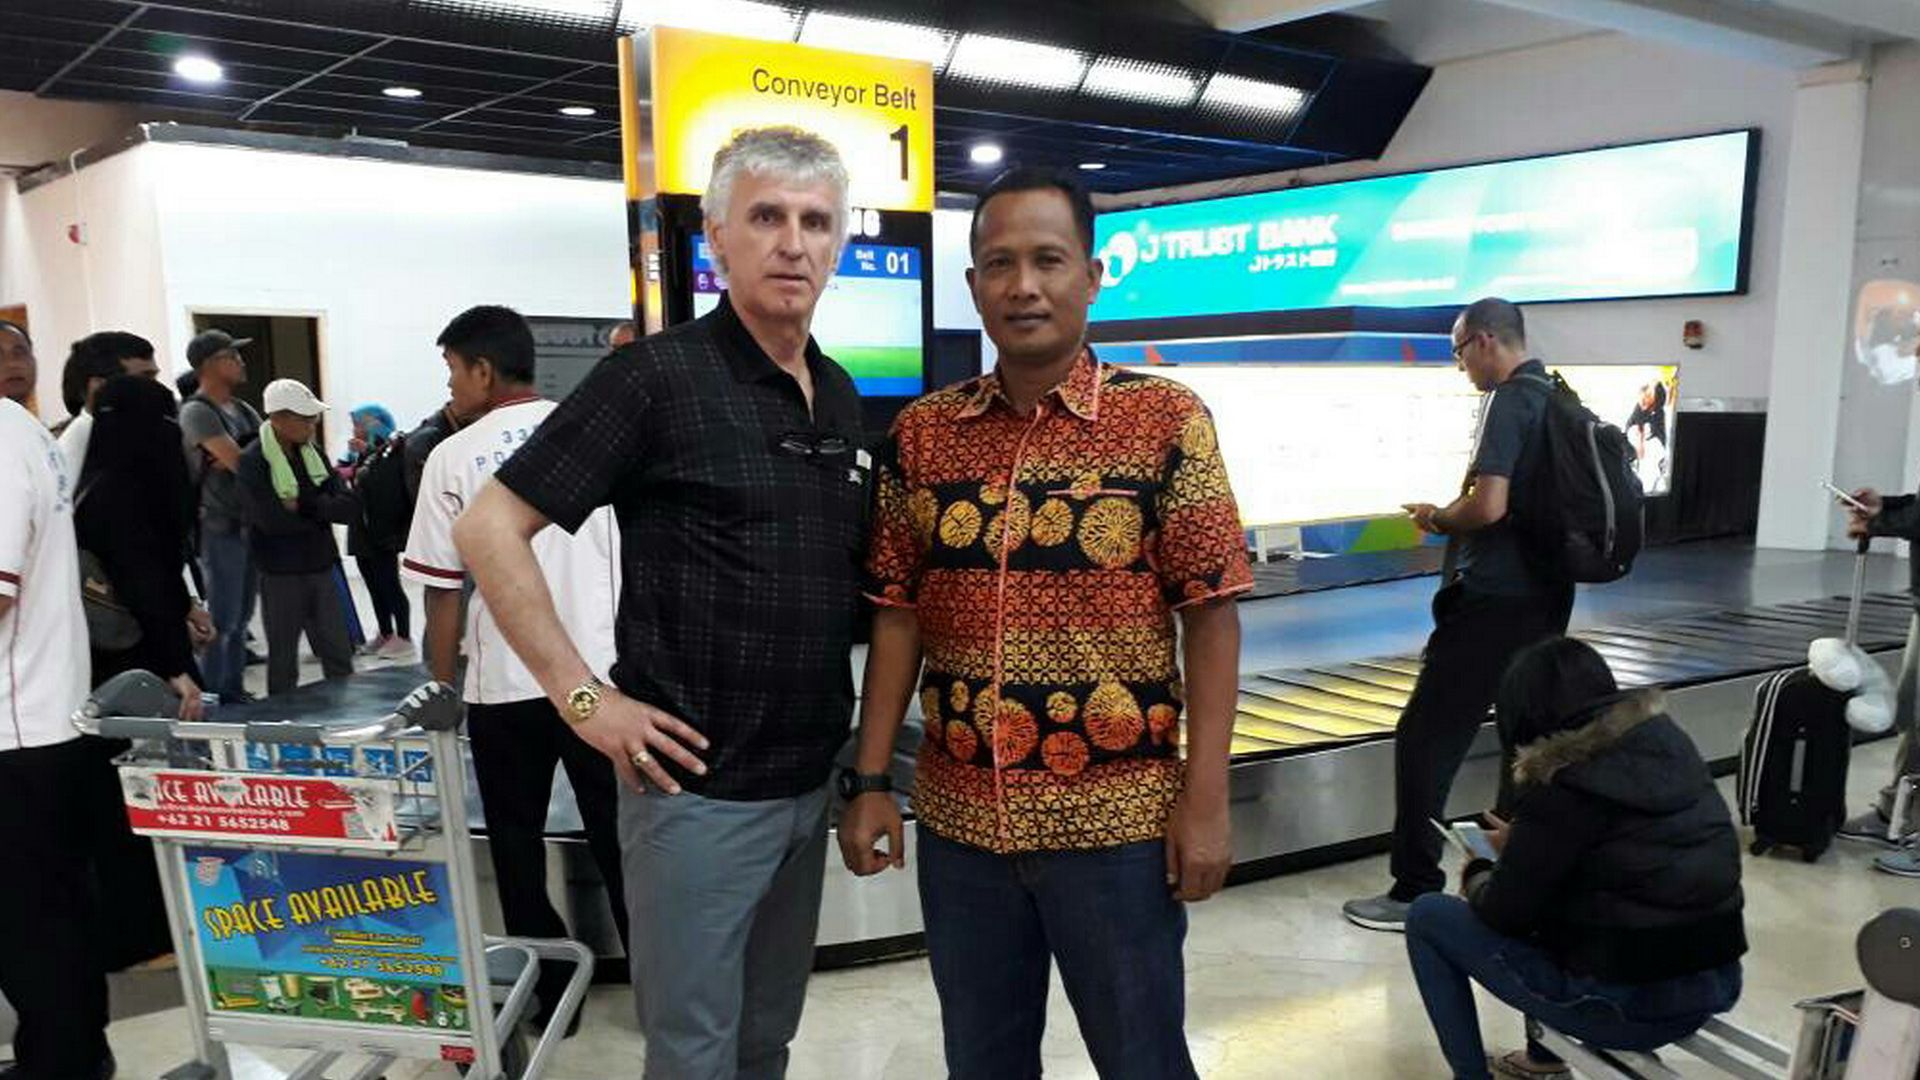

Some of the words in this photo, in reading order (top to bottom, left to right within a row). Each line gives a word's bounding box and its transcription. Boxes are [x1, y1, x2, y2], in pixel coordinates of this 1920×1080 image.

[752, 68, 866, 107] Conveyor
[874, 84, 917, 111] Belt
[889, 124, 909, 182] 1
[1161, 224, 1253, 259] TRUST
[1257, 214, 1340, 250] BANK
[886, 252, 910, 274] 01
[157, 813, 187, 826] +62
[194, 815, 211, 827] 21
[203, 897, 285, 940] SPACE
[288, 870, 438, 925] AVAILABLE
